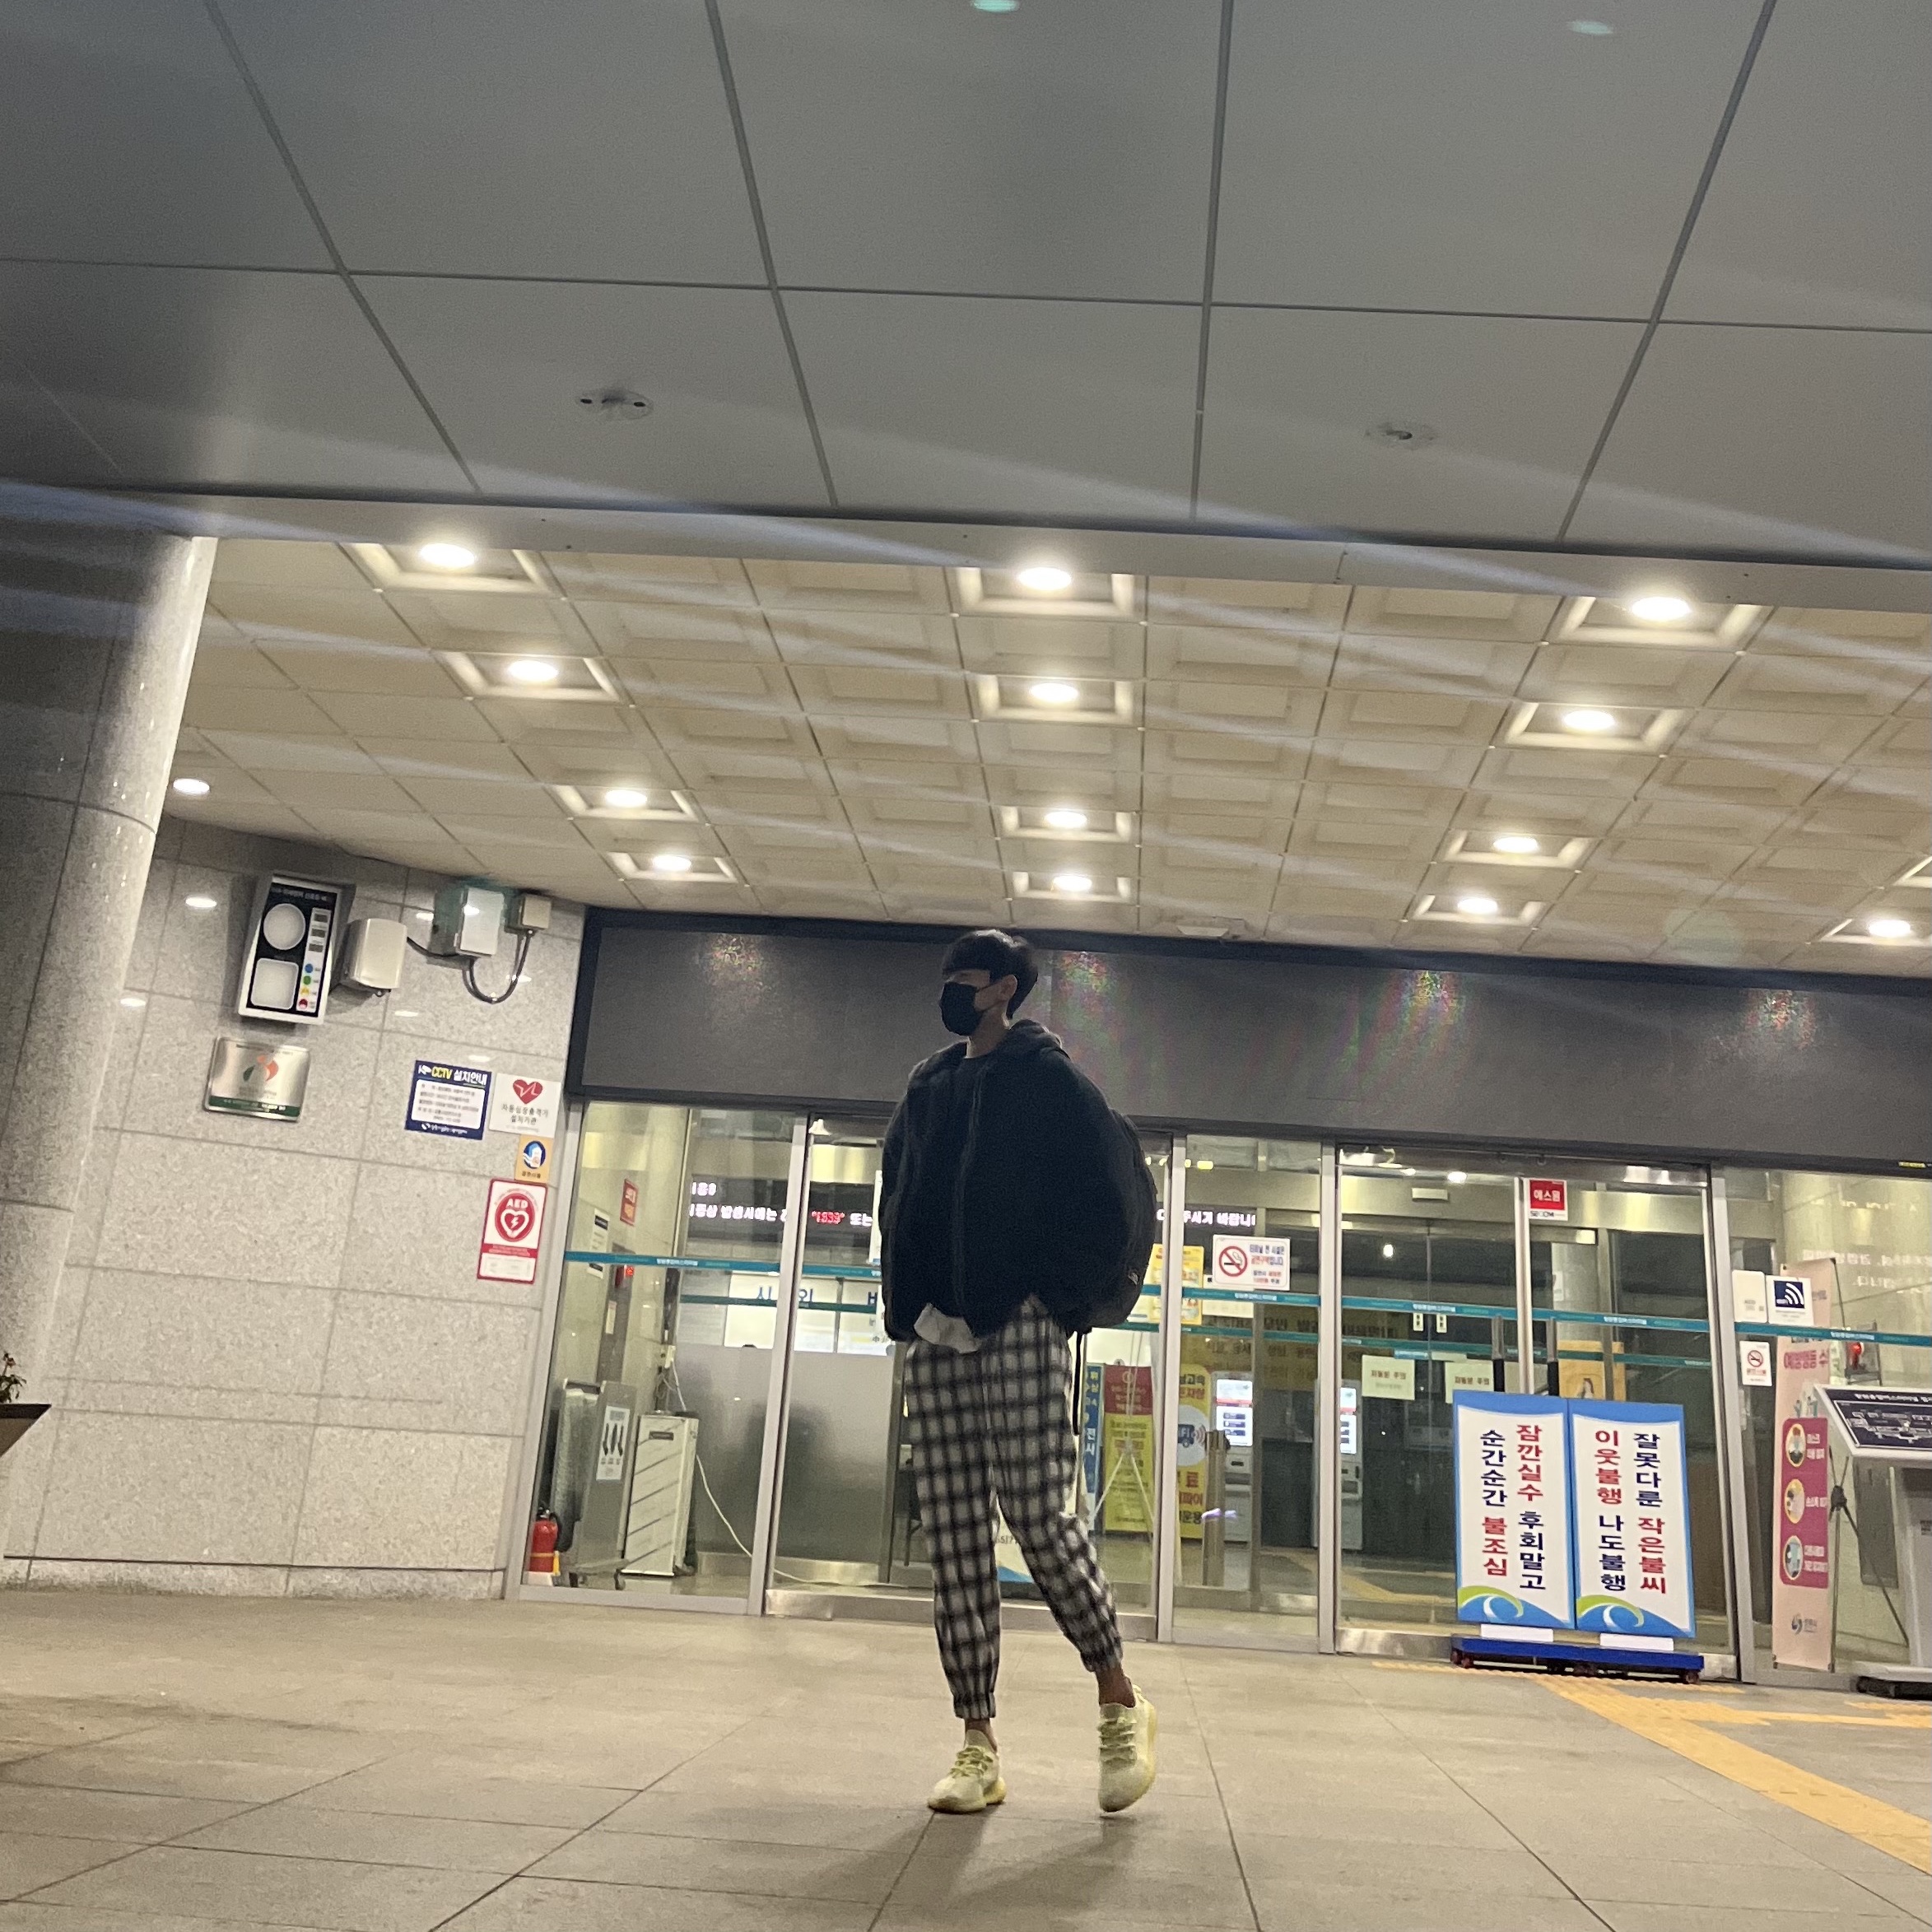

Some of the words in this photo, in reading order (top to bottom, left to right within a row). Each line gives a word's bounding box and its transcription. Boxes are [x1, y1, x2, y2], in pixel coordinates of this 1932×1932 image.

[431, 1066, 453, 1080] CCTV
[453, 1068, 488, 1086] 설치안내
[505, 1198, 528, 1208] AED
[1533, 1189, 1561, 1202] 에스원
[1480, 1429, 1508, 1507] 순간순간
[1515, 1424, 1543, 1501] 잠깐실수
[1594, 1430, 1622, 1506] 이웃불행
[1633, 1432, 1663, 1508] 잘못다룬
[1482, 1516, 1509, 1577] 불조심
[1518, 1511, 1547, 1590] 후회말고
[1598, 1515, 1626, 1592] 나도불행
[1638, 1517, 1667, 1594] 작은불씨
